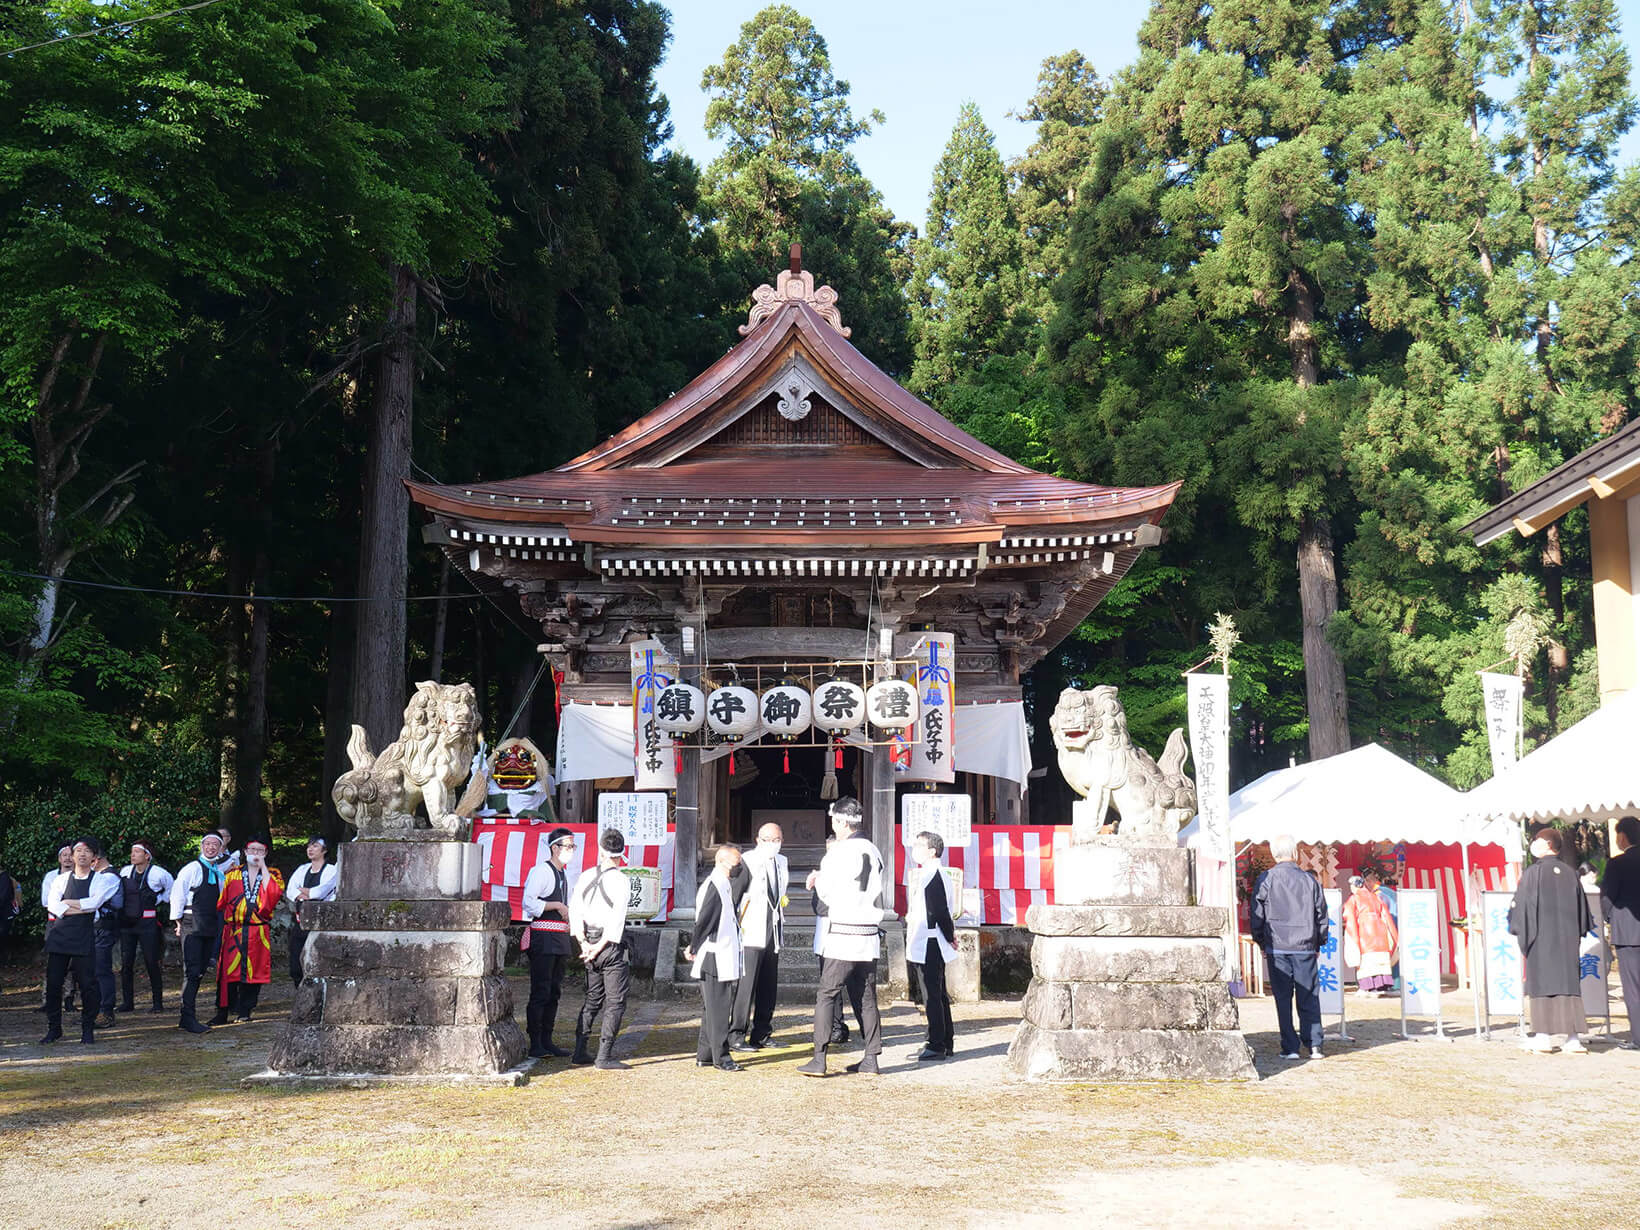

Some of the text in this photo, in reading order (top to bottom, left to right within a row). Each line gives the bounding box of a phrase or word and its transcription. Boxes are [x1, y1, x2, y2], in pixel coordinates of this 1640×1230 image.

[925, 708, 944, 765] 氏子中
[1318, 917, 1339, 993] 神楽
[1407, 902, 1435, 995] 屋台長
[1580, 915, 1601, 980] 賓
